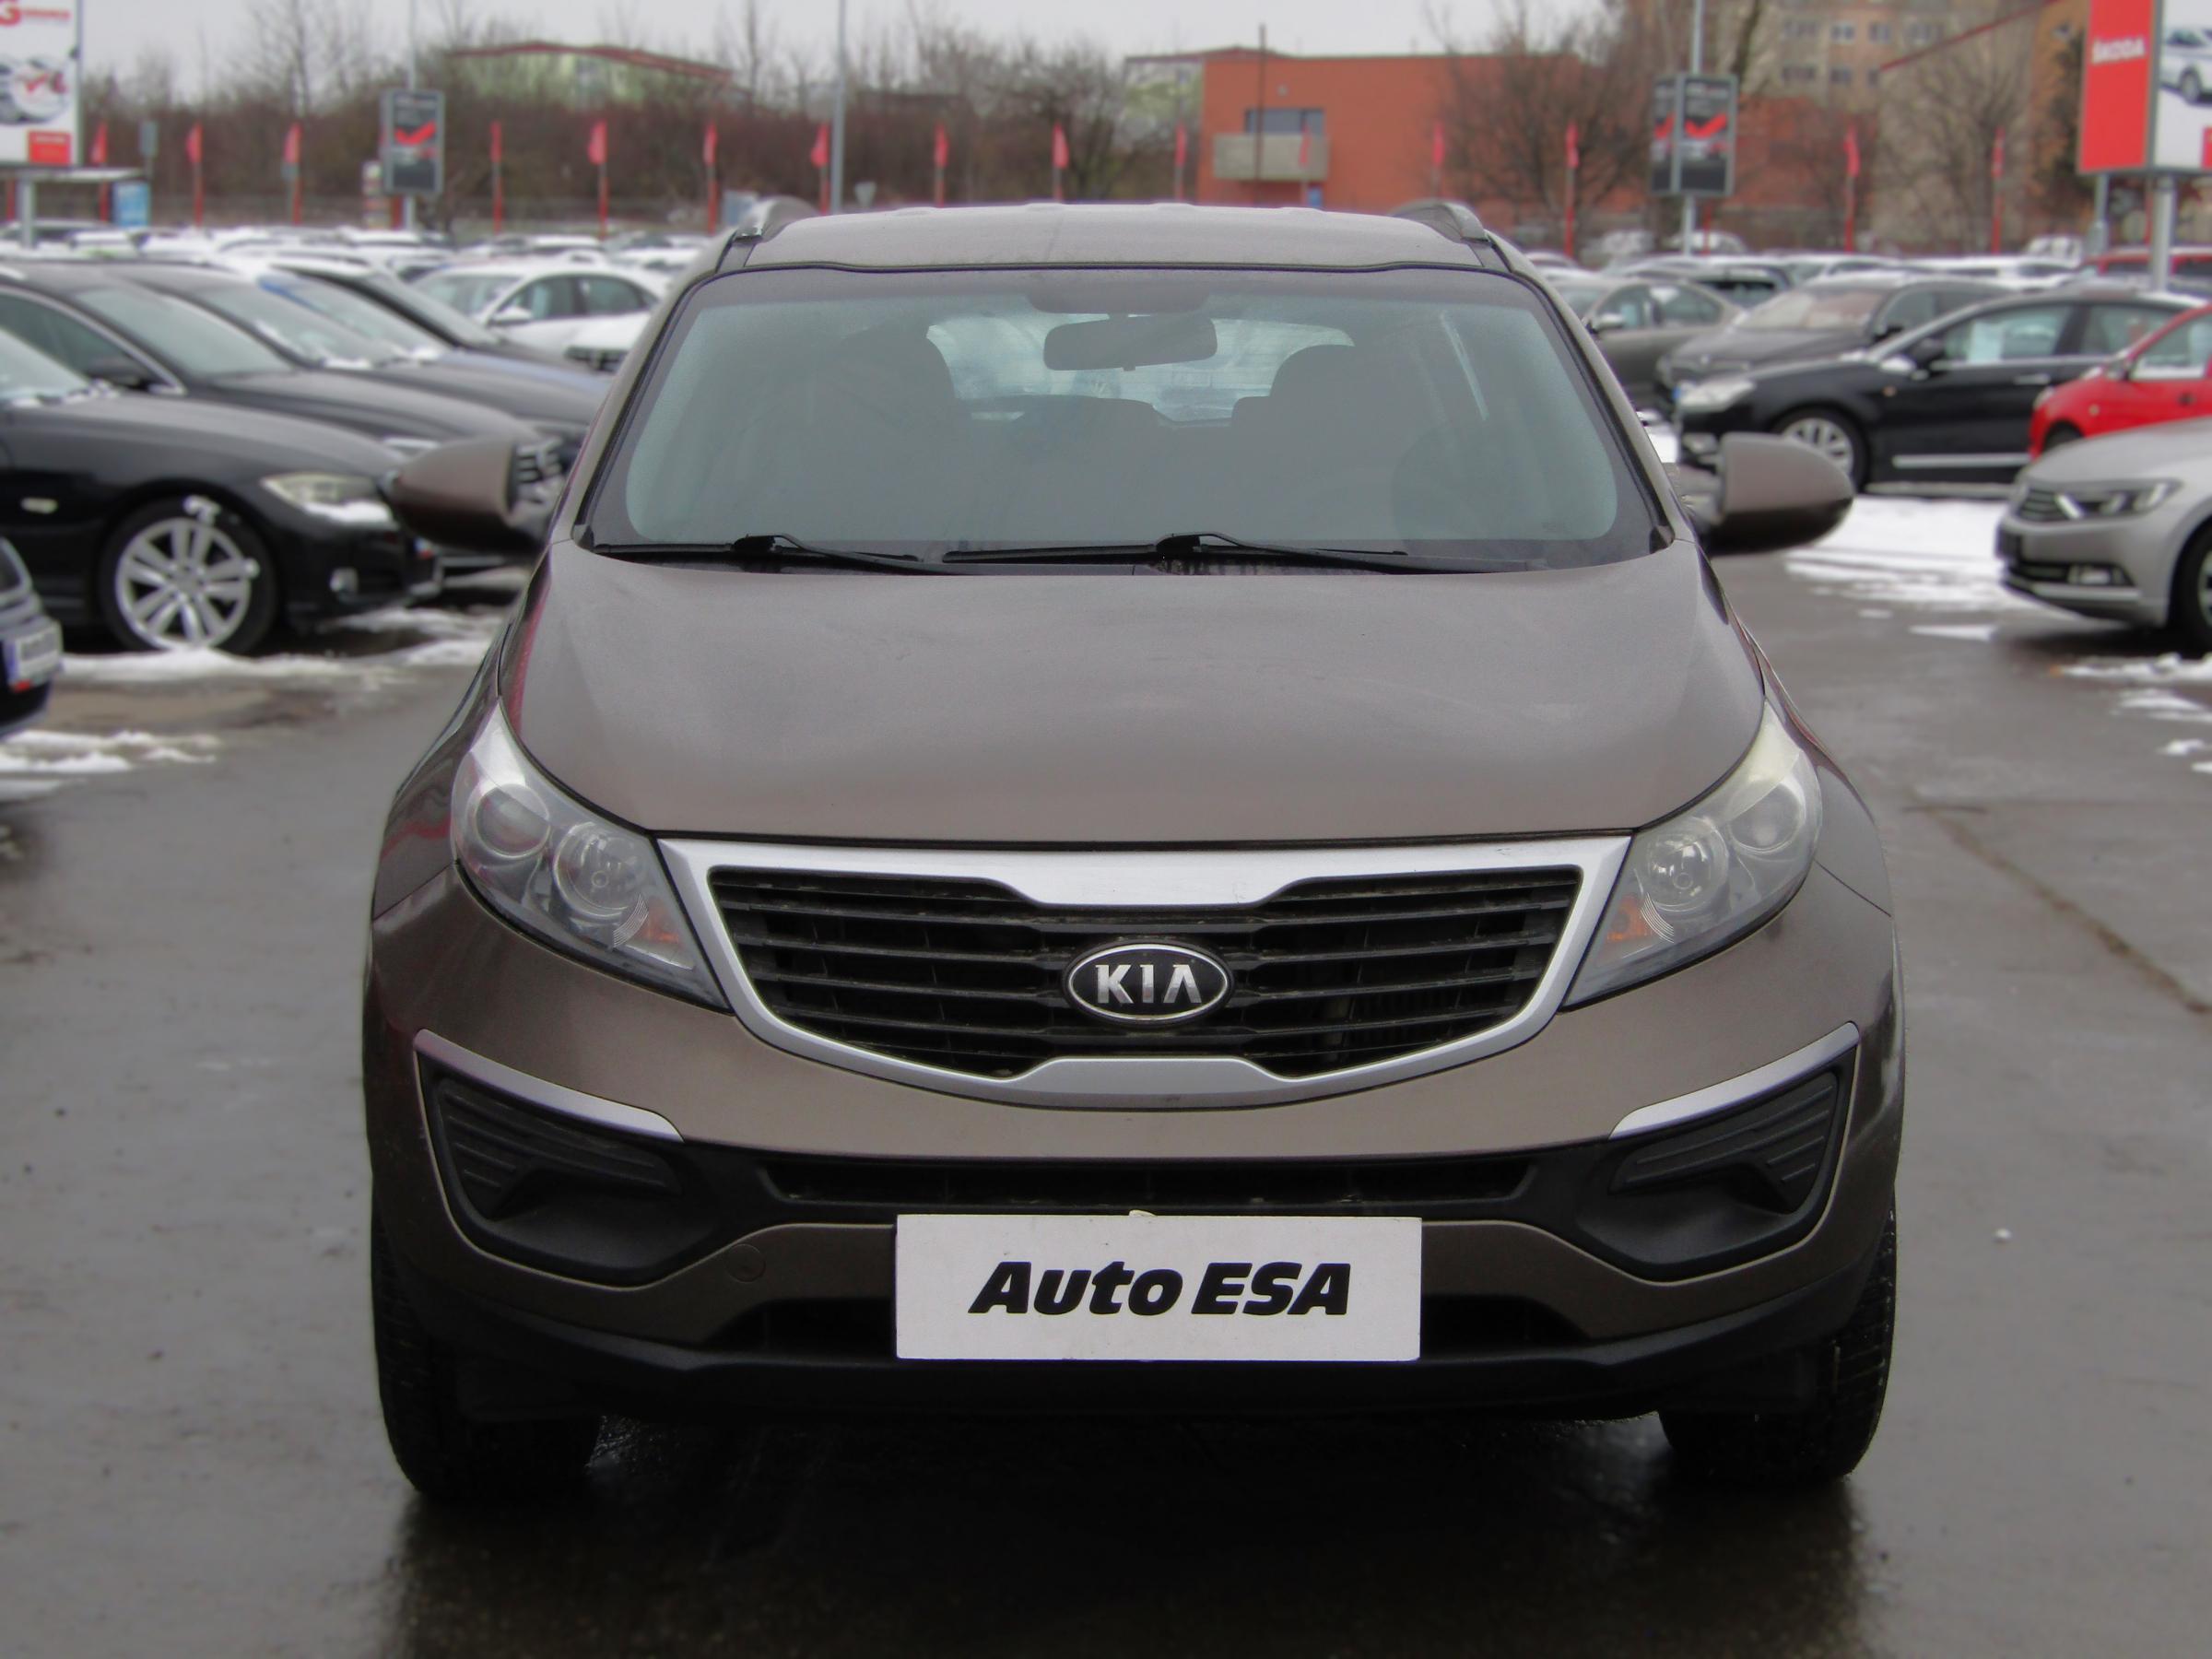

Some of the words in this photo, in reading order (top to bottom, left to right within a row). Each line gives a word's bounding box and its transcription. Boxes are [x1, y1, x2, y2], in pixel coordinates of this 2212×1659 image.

[1095, 964, 1202, 1005] KIA
[968, 1261, 1183, 1315] Auto
[1191, 1262, 1351, 1316] ESA
